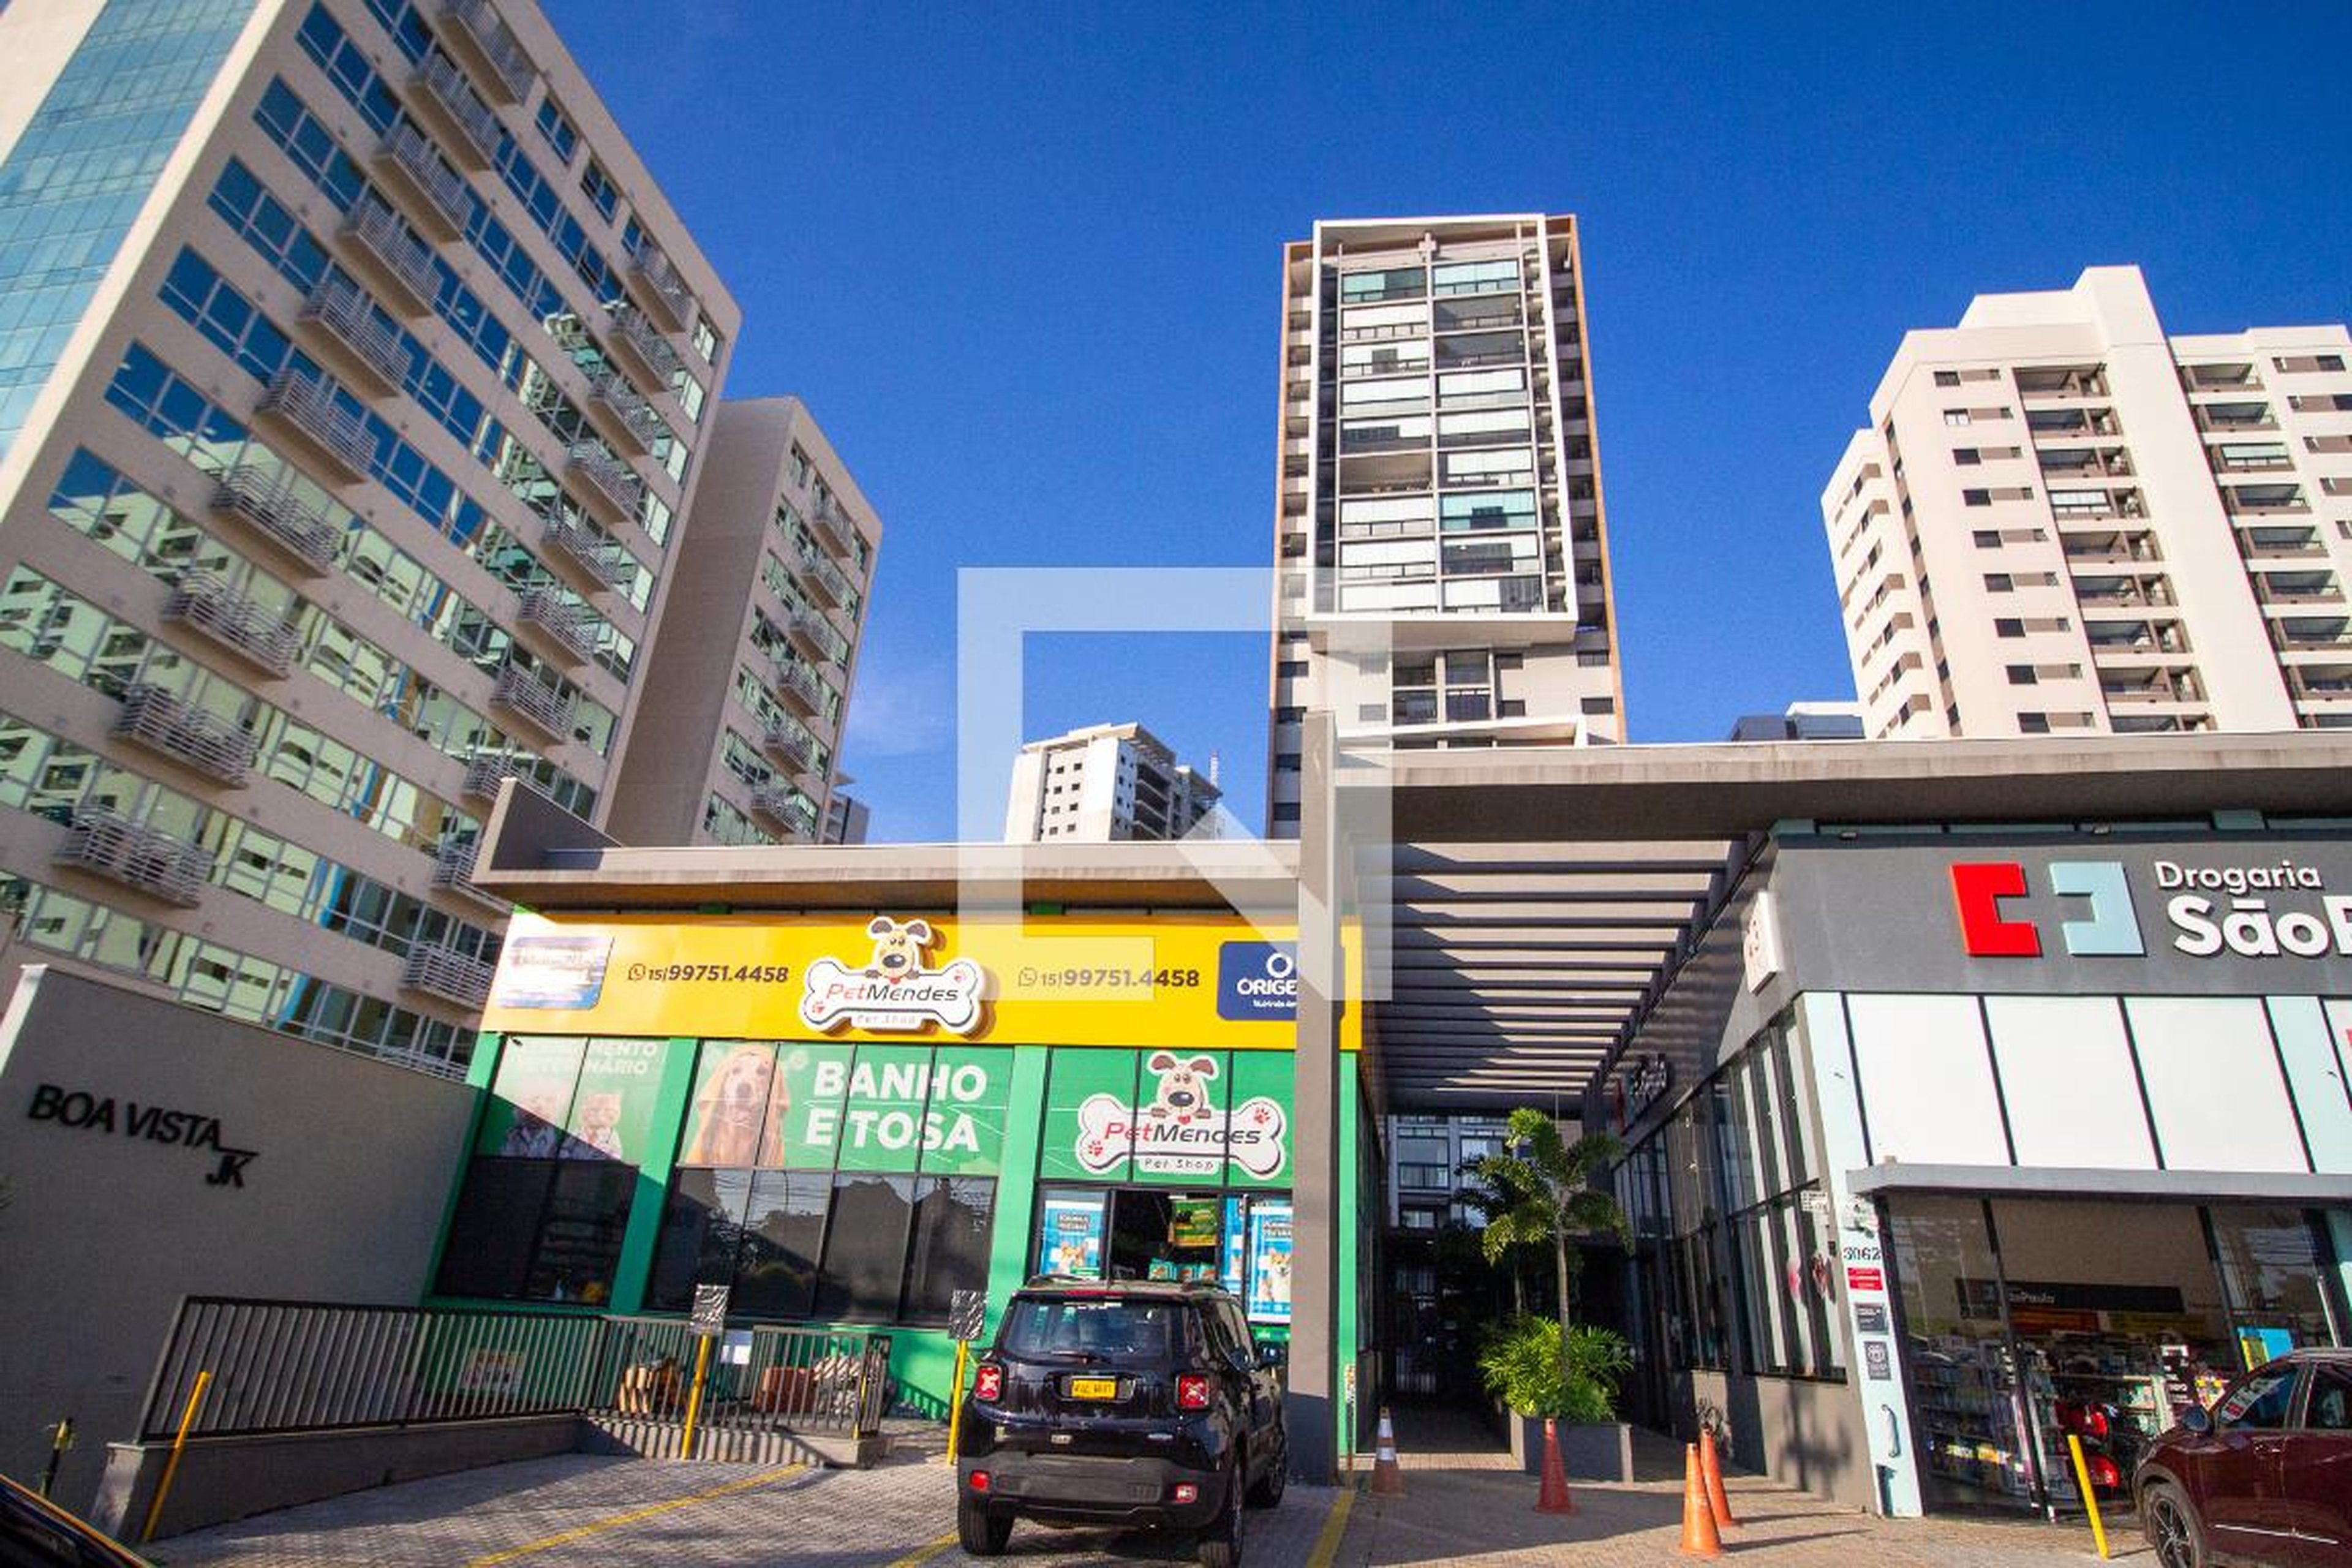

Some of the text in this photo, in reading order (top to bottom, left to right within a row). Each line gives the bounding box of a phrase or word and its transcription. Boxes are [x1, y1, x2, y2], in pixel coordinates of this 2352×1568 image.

[2155, 860, 2322, 895] Drogaria
[826, 983, 959, 1001] PetMendes
[813, 1060, 987, 1102] BANHO
[28, 1084, 222, 1152] BOA VISTA
[806, 1107, 980, 1152] E TOSA
[1104, 1122, 1261, 1144] PetMendes
[205, 1155, 250, 1188] JK
[1145, 1158, 1213, 1171] Pet Shop
[1843, 1246, 1881, 1261] 3062
